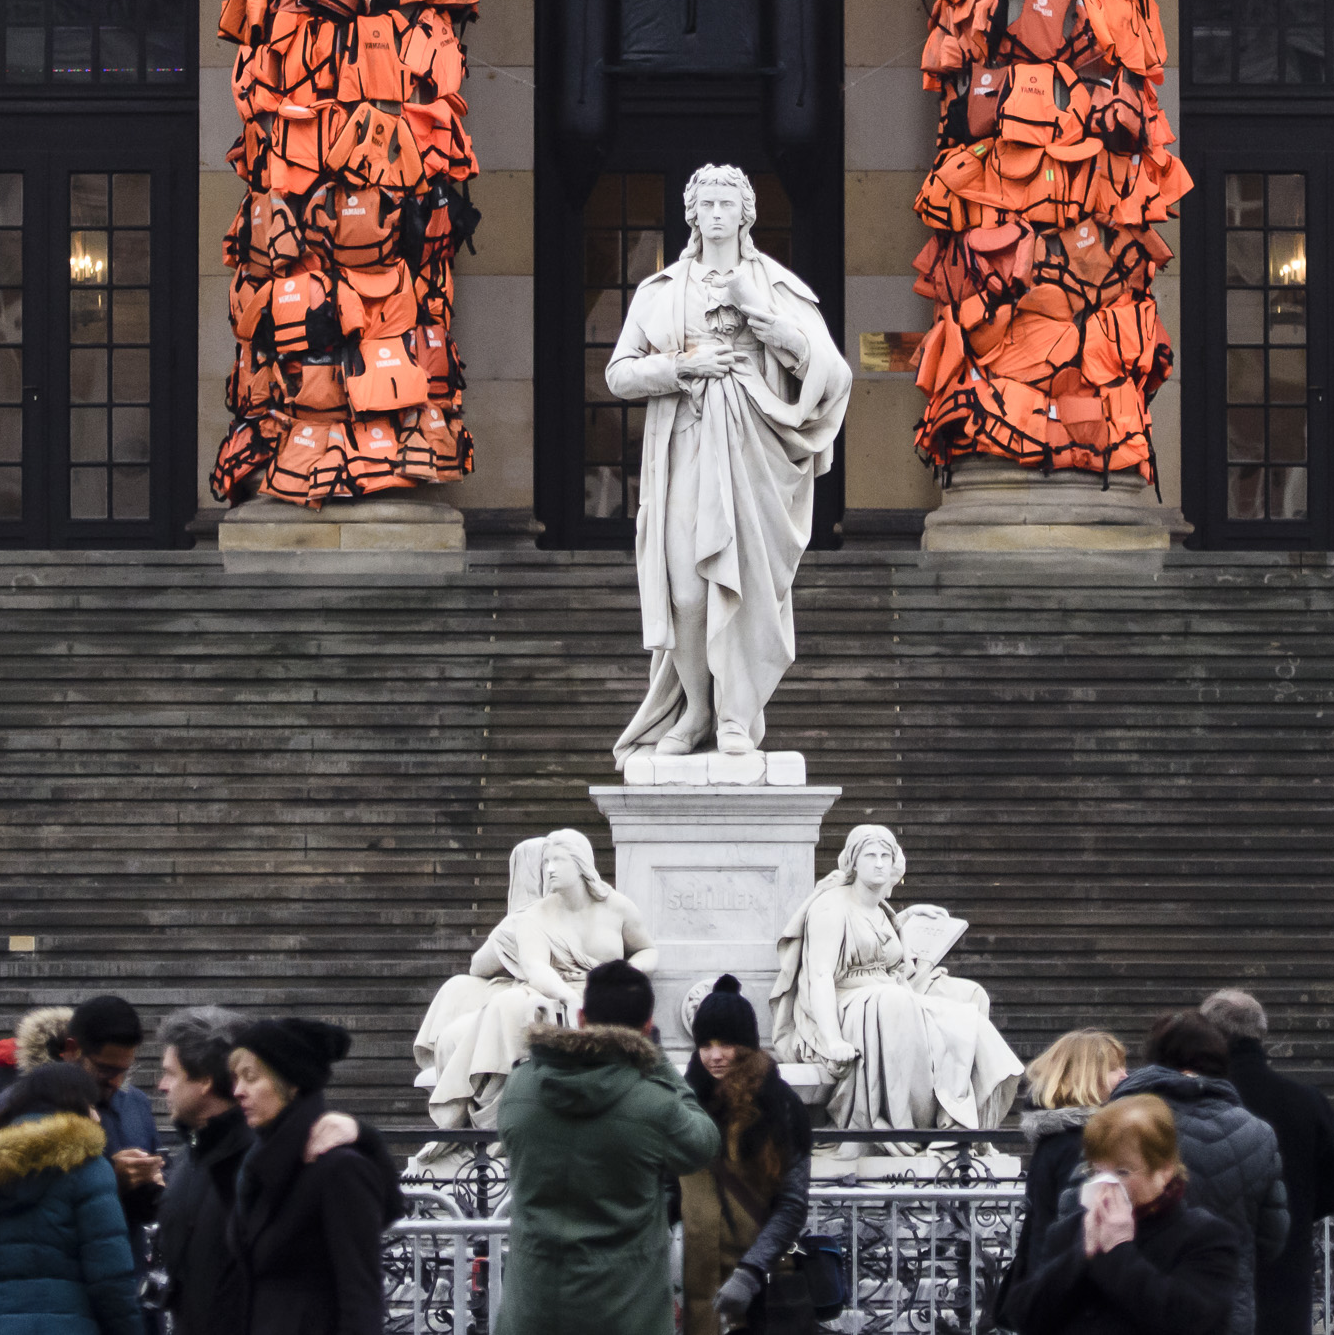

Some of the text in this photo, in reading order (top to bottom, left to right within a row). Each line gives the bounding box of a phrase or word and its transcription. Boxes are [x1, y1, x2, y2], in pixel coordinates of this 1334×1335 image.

[364, 42, 390, 51] YAMAHA
[1020, 86, 1045, 96] YAMAHA
[342, 207, 366, 216] YAMAHA
[278, 294, 301, 304] YAMAHA
[667, 890, 759, 911] SCHILLER
